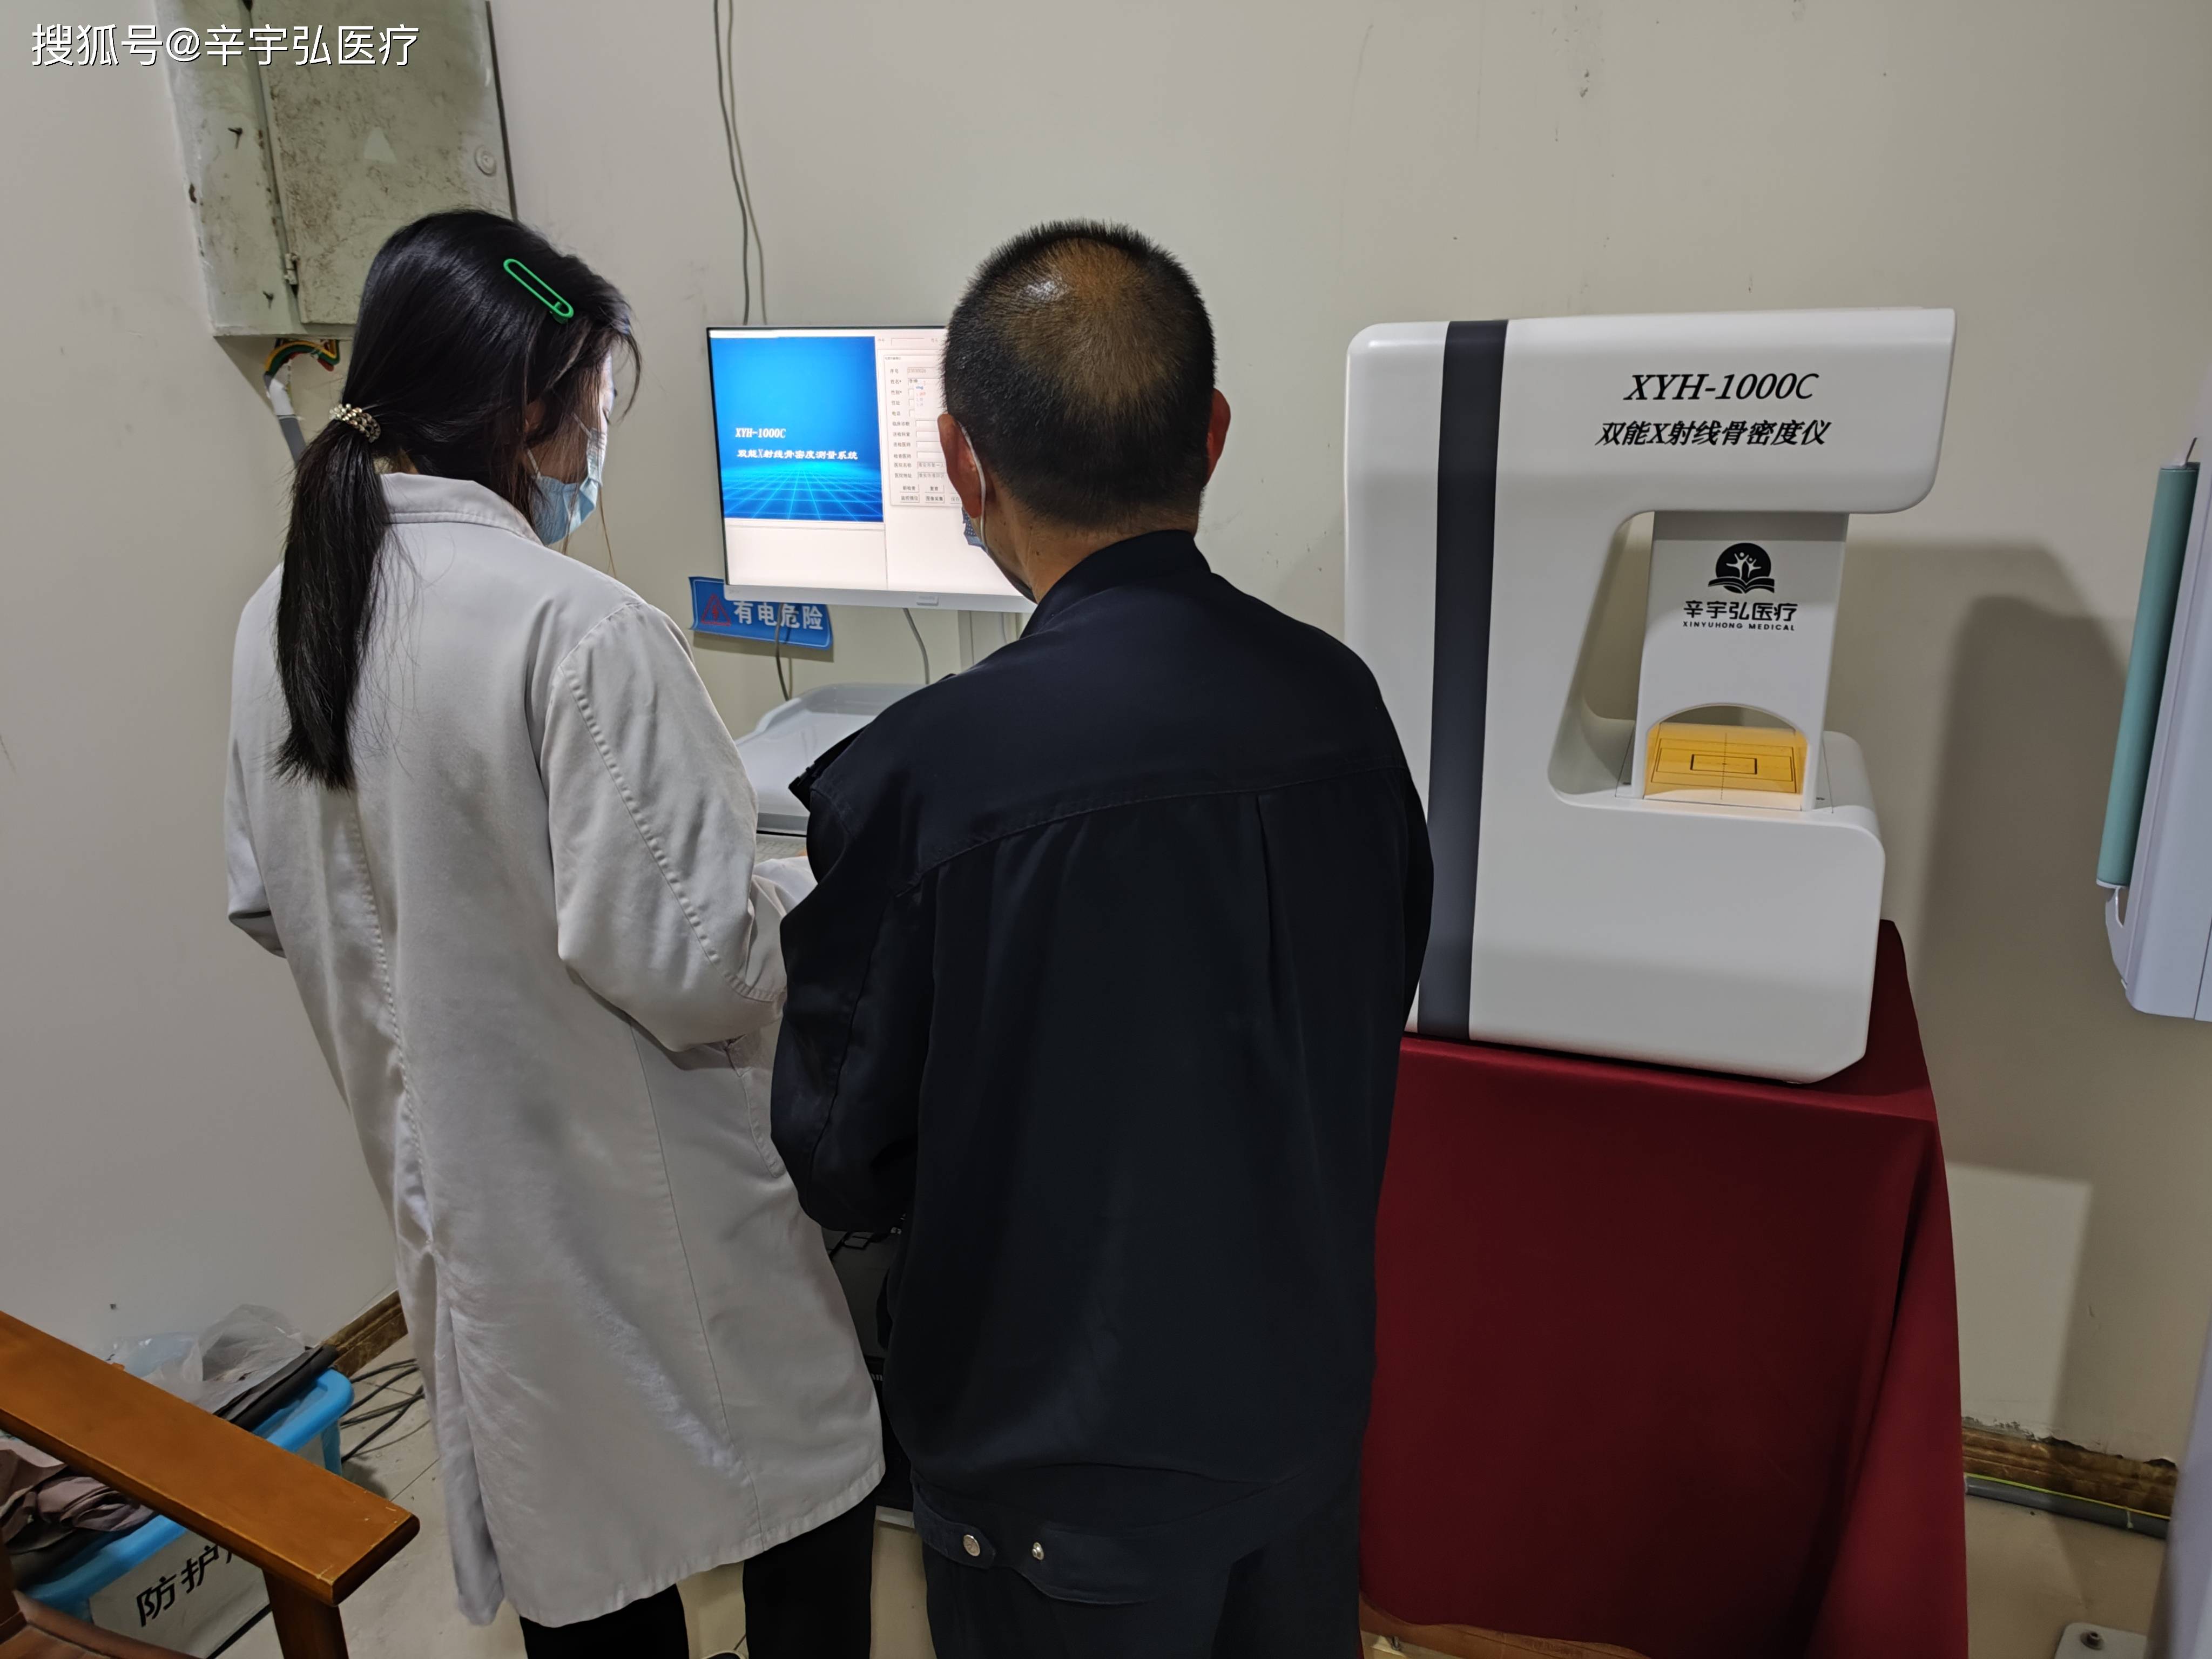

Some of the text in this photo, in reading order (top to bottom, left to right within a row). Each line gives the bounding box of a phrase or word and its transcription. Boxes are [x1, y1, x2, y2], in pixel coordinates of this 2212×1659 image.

[1623, 373, 1820, 400] XYH-1000C
[735, 427, 787, 439] XYH-1000C
[1595, 419, 1832, 446] 双能X射线骨密度仪
[737, 449, 859, 460] 双能X射线骨密度测量系统
[732, 600, 824, 631] 有电危险
[1683, 599, 1798, 622] 辛宇弘医疗
[1682, 621, 1795, 632] XINYUHONG MEDICAL
[136, 1545, 233, 1628] 防护
